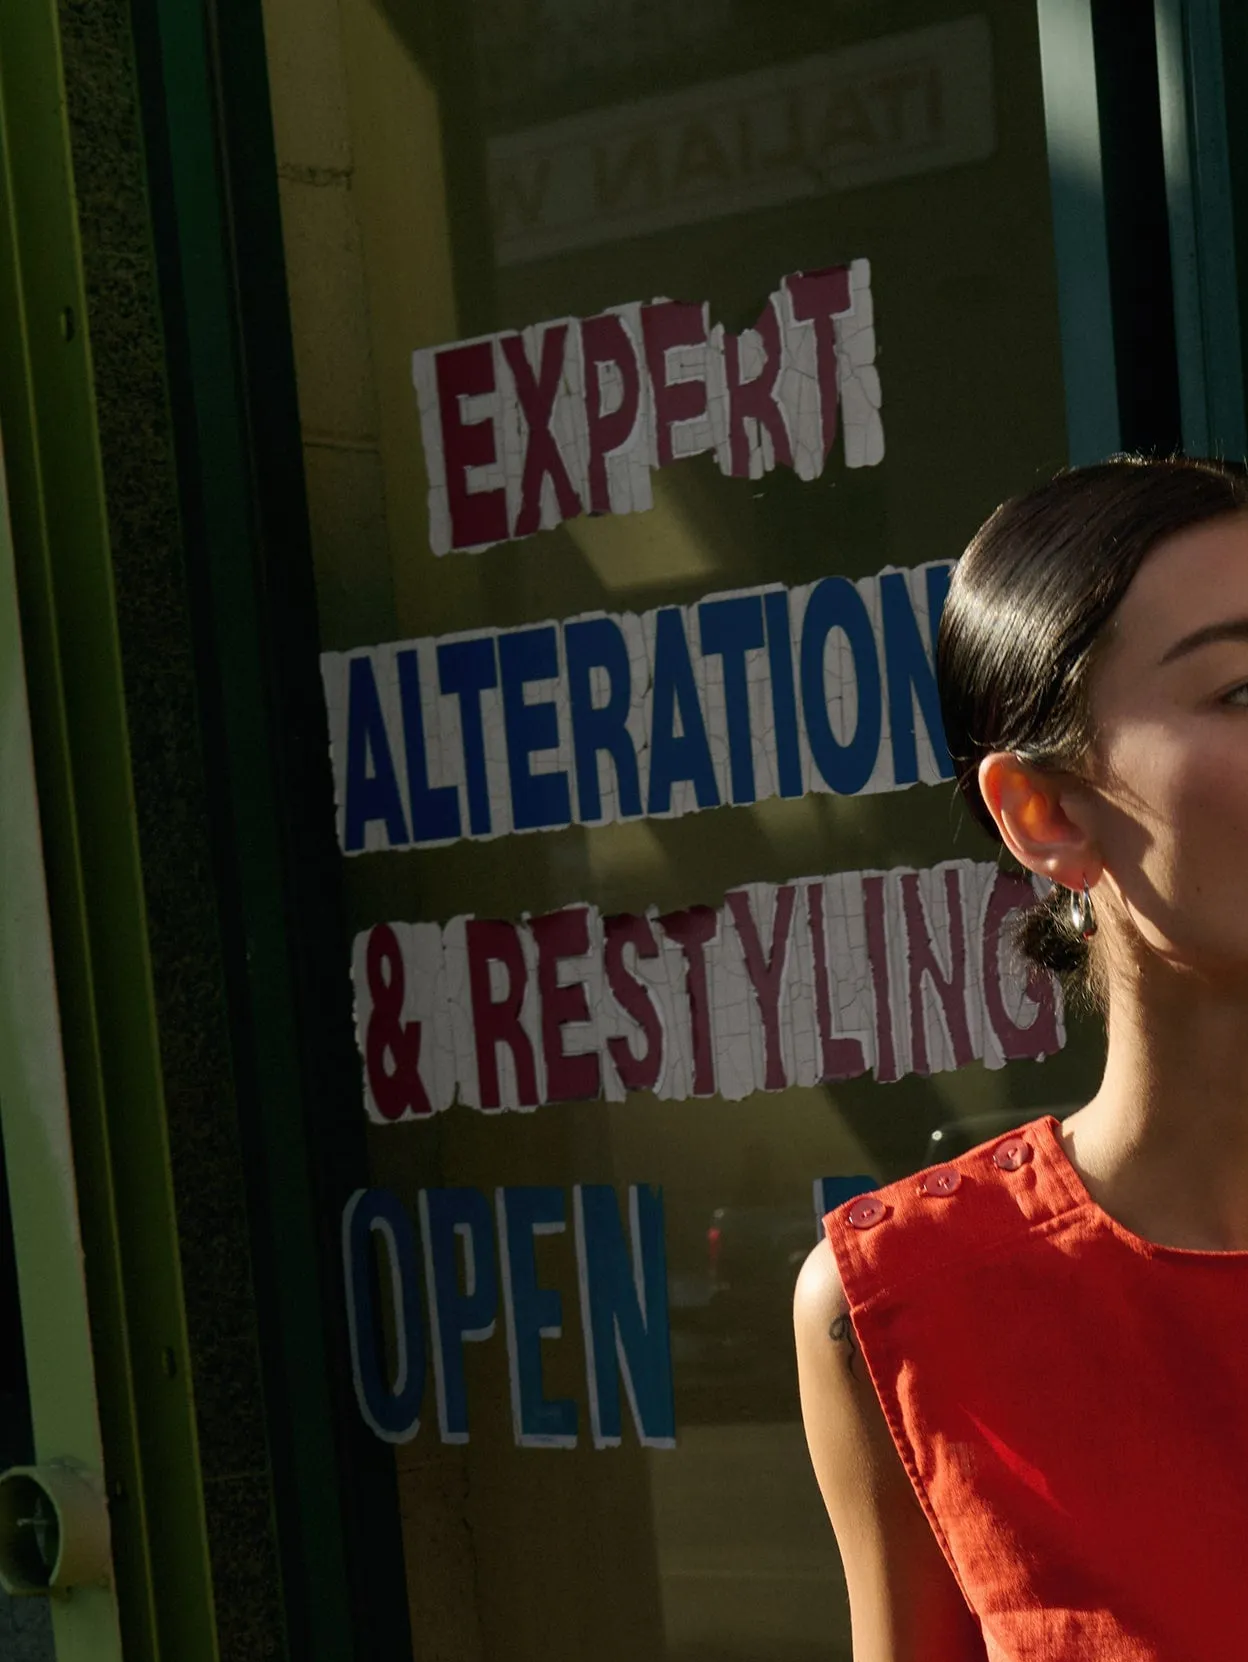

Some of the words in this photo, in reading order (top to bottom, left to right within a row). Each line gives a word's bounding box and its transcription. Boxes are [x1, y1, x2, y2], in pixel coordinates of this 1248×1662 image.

[434, 263, 852, 549] EXPERT
[344, 564, 956, 852] ALTERATION
[366, 922, 432, 1119] &
[465, 867, 1058, 1110] RESTYLING
[342, 1183, 677, 1449] OPEN
